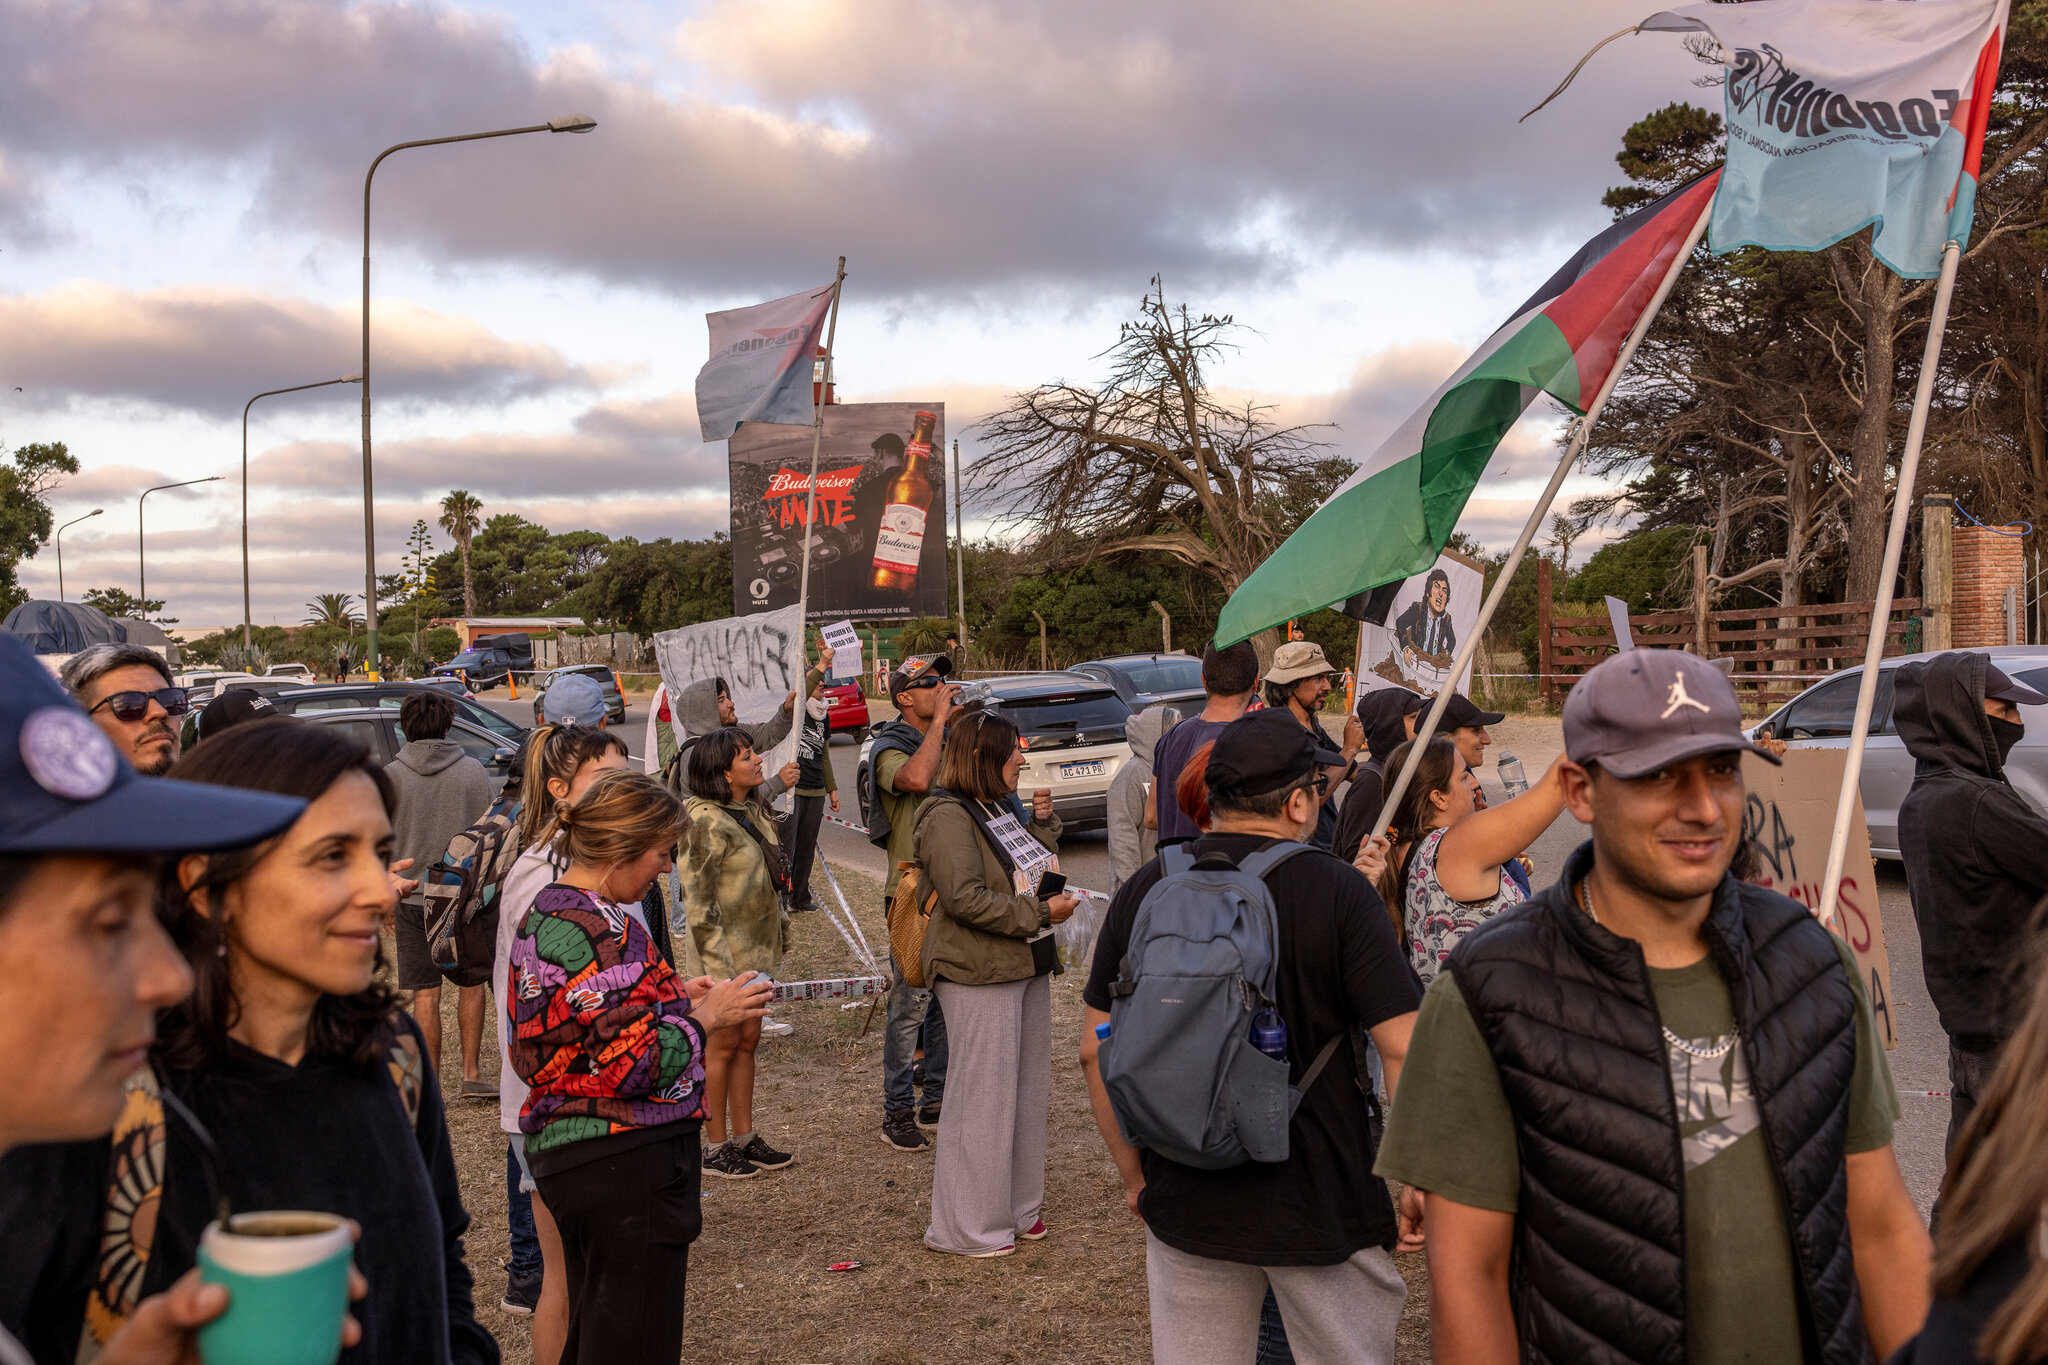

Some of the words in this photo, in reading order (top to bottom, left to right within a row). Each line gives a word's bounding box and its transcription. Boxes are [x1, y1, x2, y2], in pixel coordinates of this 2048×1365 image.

[879, 534, 921, 551] Budweiser
[824, 628, 846, 640] APAGUEN
[846, 626, 853, 634] EL
[830, 639, 847, 649] FUEGO
[1063, 768, 1074, 778] AC
[1076, 766, 1091, 776] 471
[1092, 764, 1104, 775] PR
